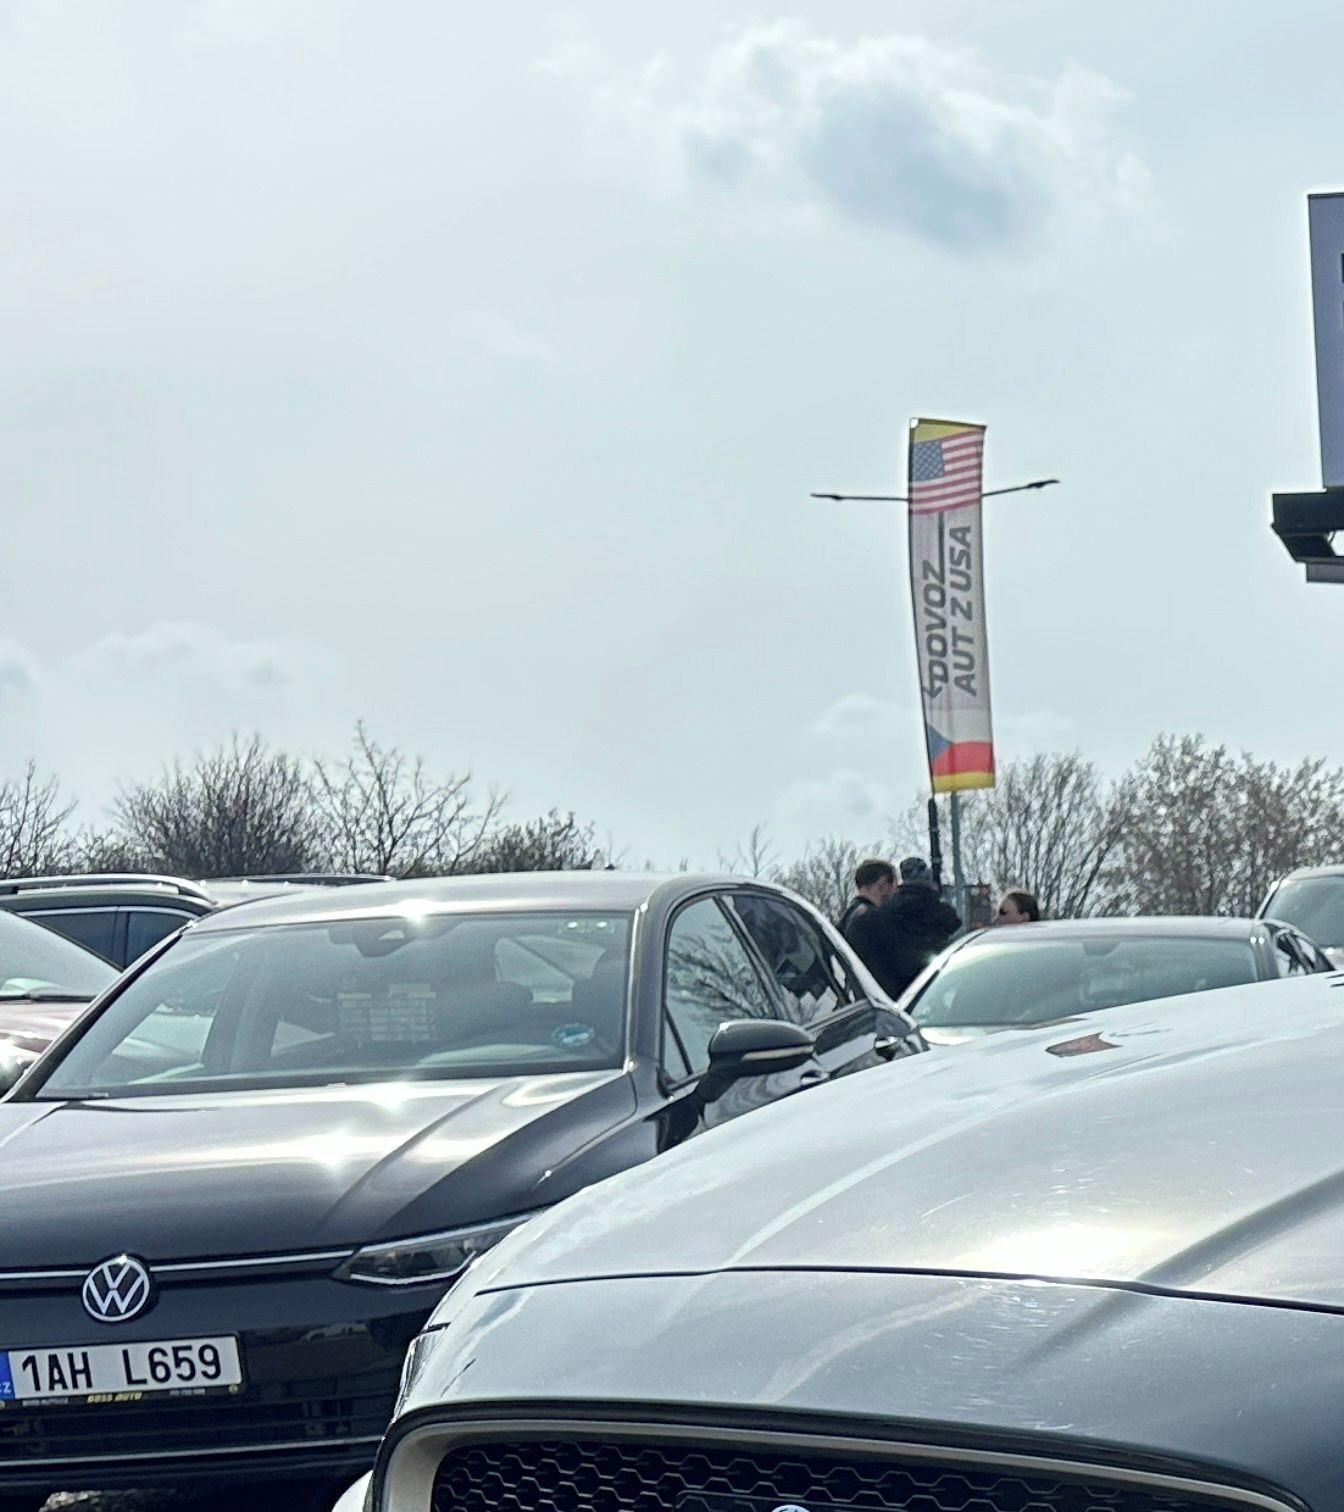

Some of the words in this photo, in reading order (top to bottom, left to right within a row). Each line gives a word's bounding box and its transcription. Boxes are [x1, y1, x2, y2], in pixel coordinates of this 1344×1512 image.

[949, 525, 973, 593] USA
[923, 560, 949, 696] DOVOZ
[952, 598, 973, 623] Z
[953, 627, 978, 697] AUT
[21, 1351, 93, 1392] 1AH
[122, 1344, 222, 1386] L659
